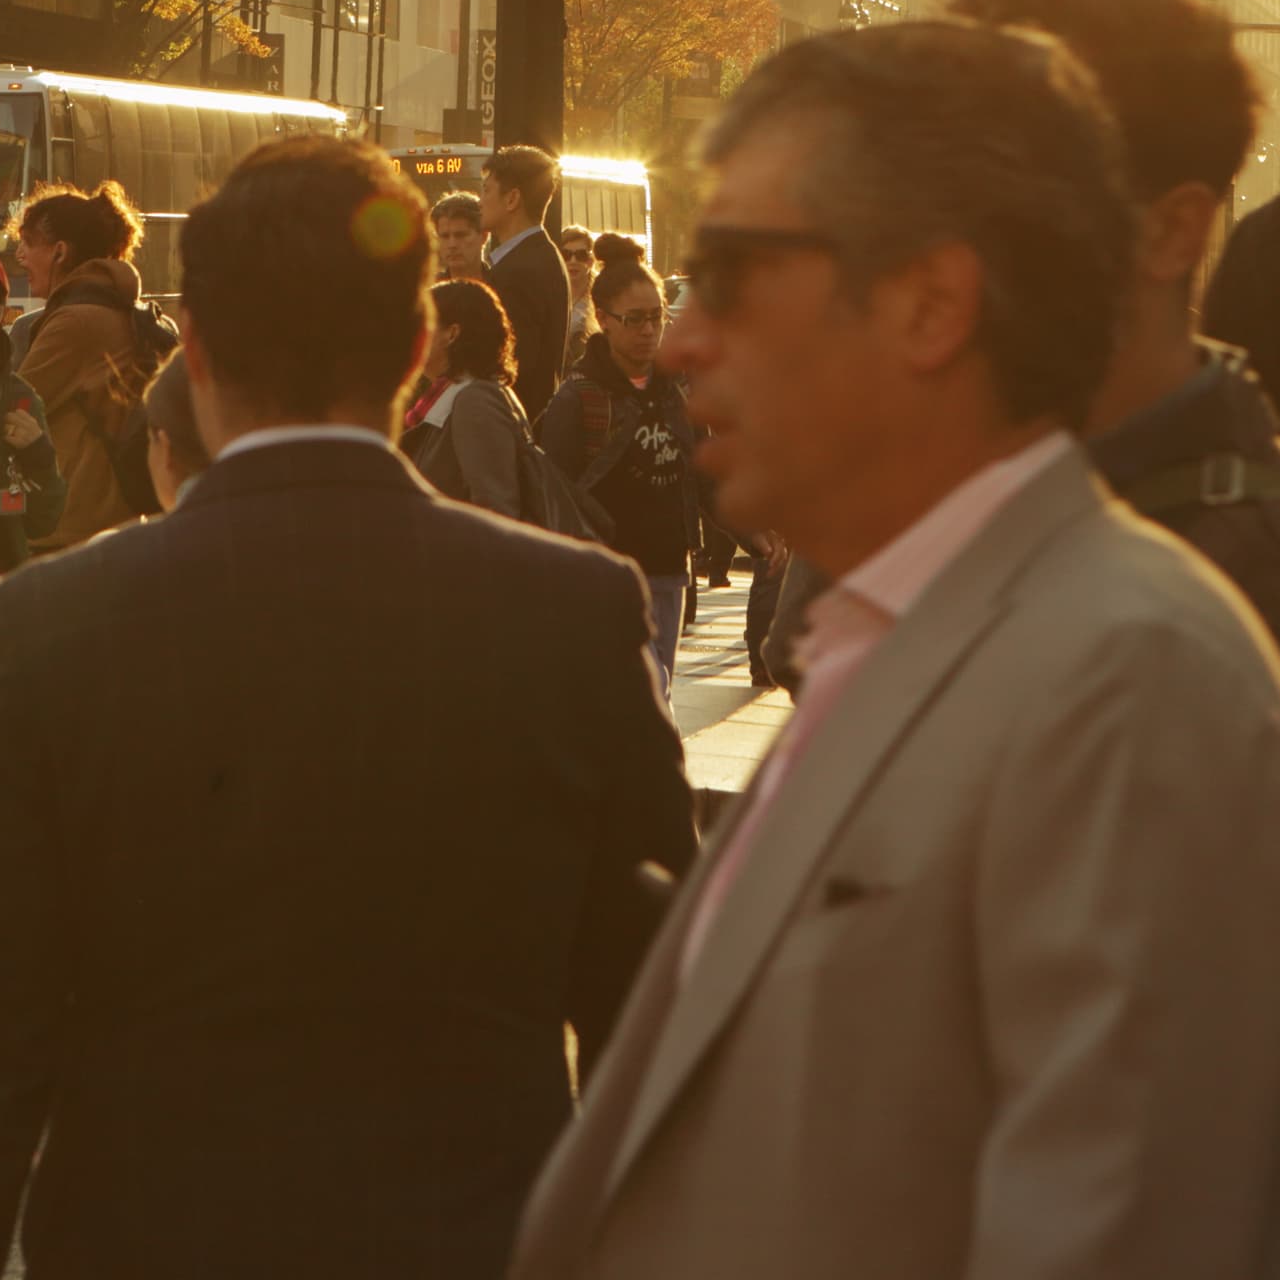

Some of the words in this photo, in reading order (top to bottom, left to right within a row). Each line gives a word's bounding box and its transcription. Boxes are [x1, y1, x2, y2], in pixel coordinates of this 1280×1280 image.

[481, 36, 496, 125] GEOX
[416, 163, 434, 174] VIA
[436, 159, 445, 173] 6
[447, 158, 462, 173] AV
